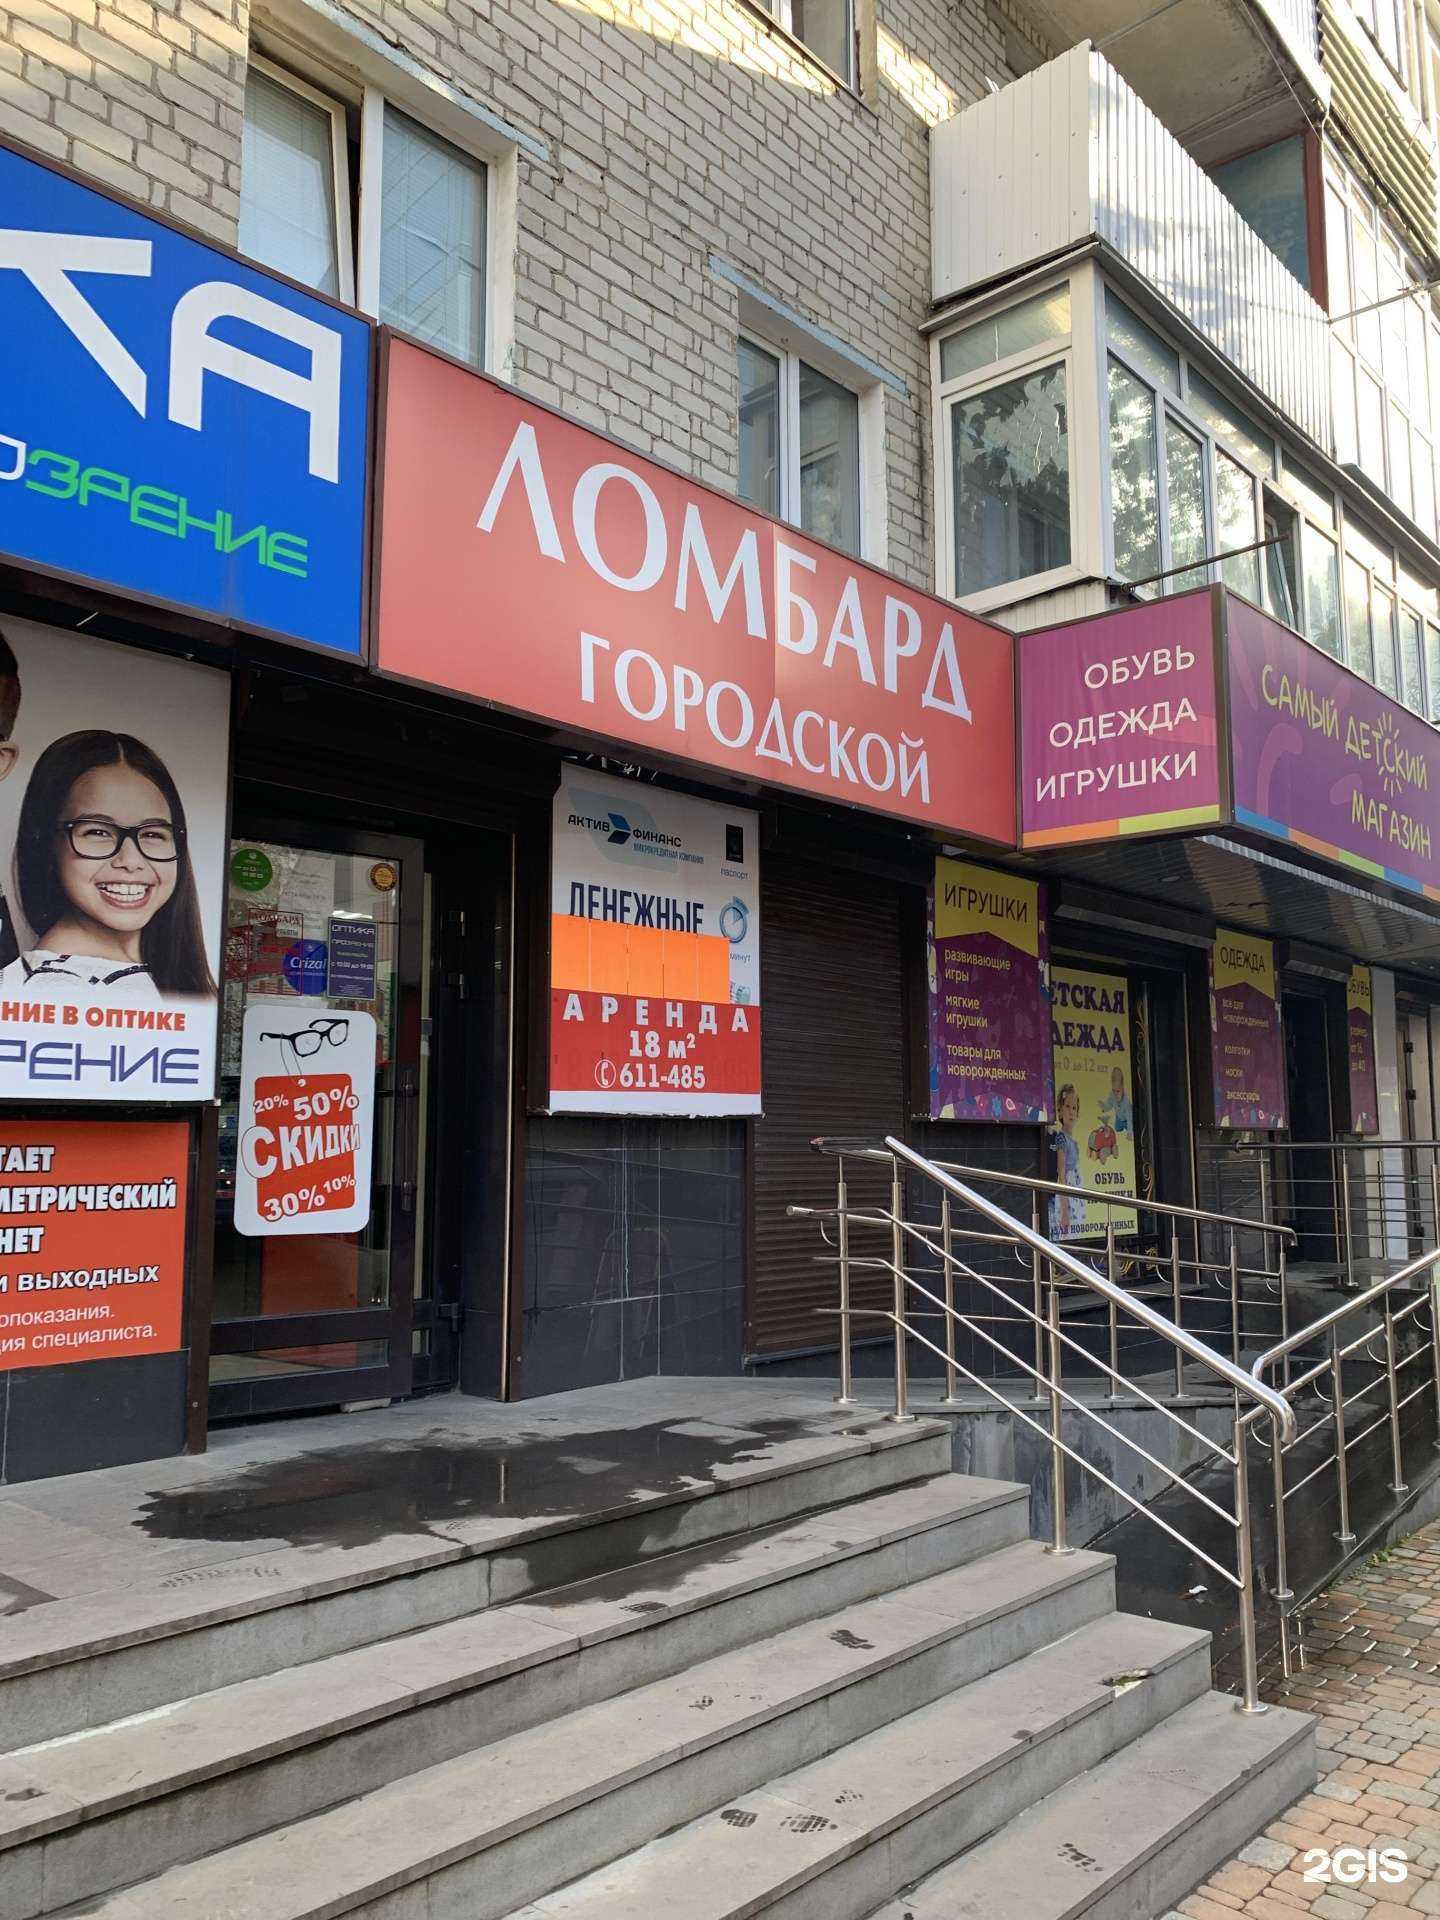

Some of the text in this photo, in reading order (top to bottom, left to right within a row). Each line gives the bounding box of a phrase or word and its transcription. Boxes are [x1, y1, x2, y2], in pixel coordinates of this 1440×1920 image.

[476, 421, 972, 725] ЛОМБАРД
[1085, 645, 1195, 689] ОБУВЬ
[580, 631, 930, 804] ГОРОДСКОЙ
[1050, 697, 1197, 749] ОДЕЖДА
[1262, 665, 1428, 791] САМЫЙ ДЕТСКИЙ
[1037, 751, 1197, 802] ИГРУШКИ
[568, 814, 682, 848] АКТИВ ФИНАНС
[1352, 789, 1431, 861] МАГАЗИН
[944, 883, 1029, 924] ИГРУШКИ
[290, 956, 326, 970] Crizal
[944, 948, 1011, 971] развивающие
[1220, 946, 1266, 974] ОДЕЖДА
[945, 968, 970, 983] игры
[562, 993, 749, 1035] АРЕНДА
[945, 995, 980, 1010] мягкие
[85, 1007, 186, 1032] ОПТИКЕ
[946, 1012, 988, 1029] игрушки
[629, 1030, 661, 1058] 18
[947, 1043, 1001, 1061] товары для
[619, 1062, 706, 1089] 611-485
[947, 1064, 1027, 1081] новорожденных
[253, 1085, 359, 1121] 20% 50%
[1095, 1172, 1125, 1184] ОБУВЬ
[264, 1174, 356, 1222] 30% 10%
[32, 1324, 158, 1351] специалиста.
